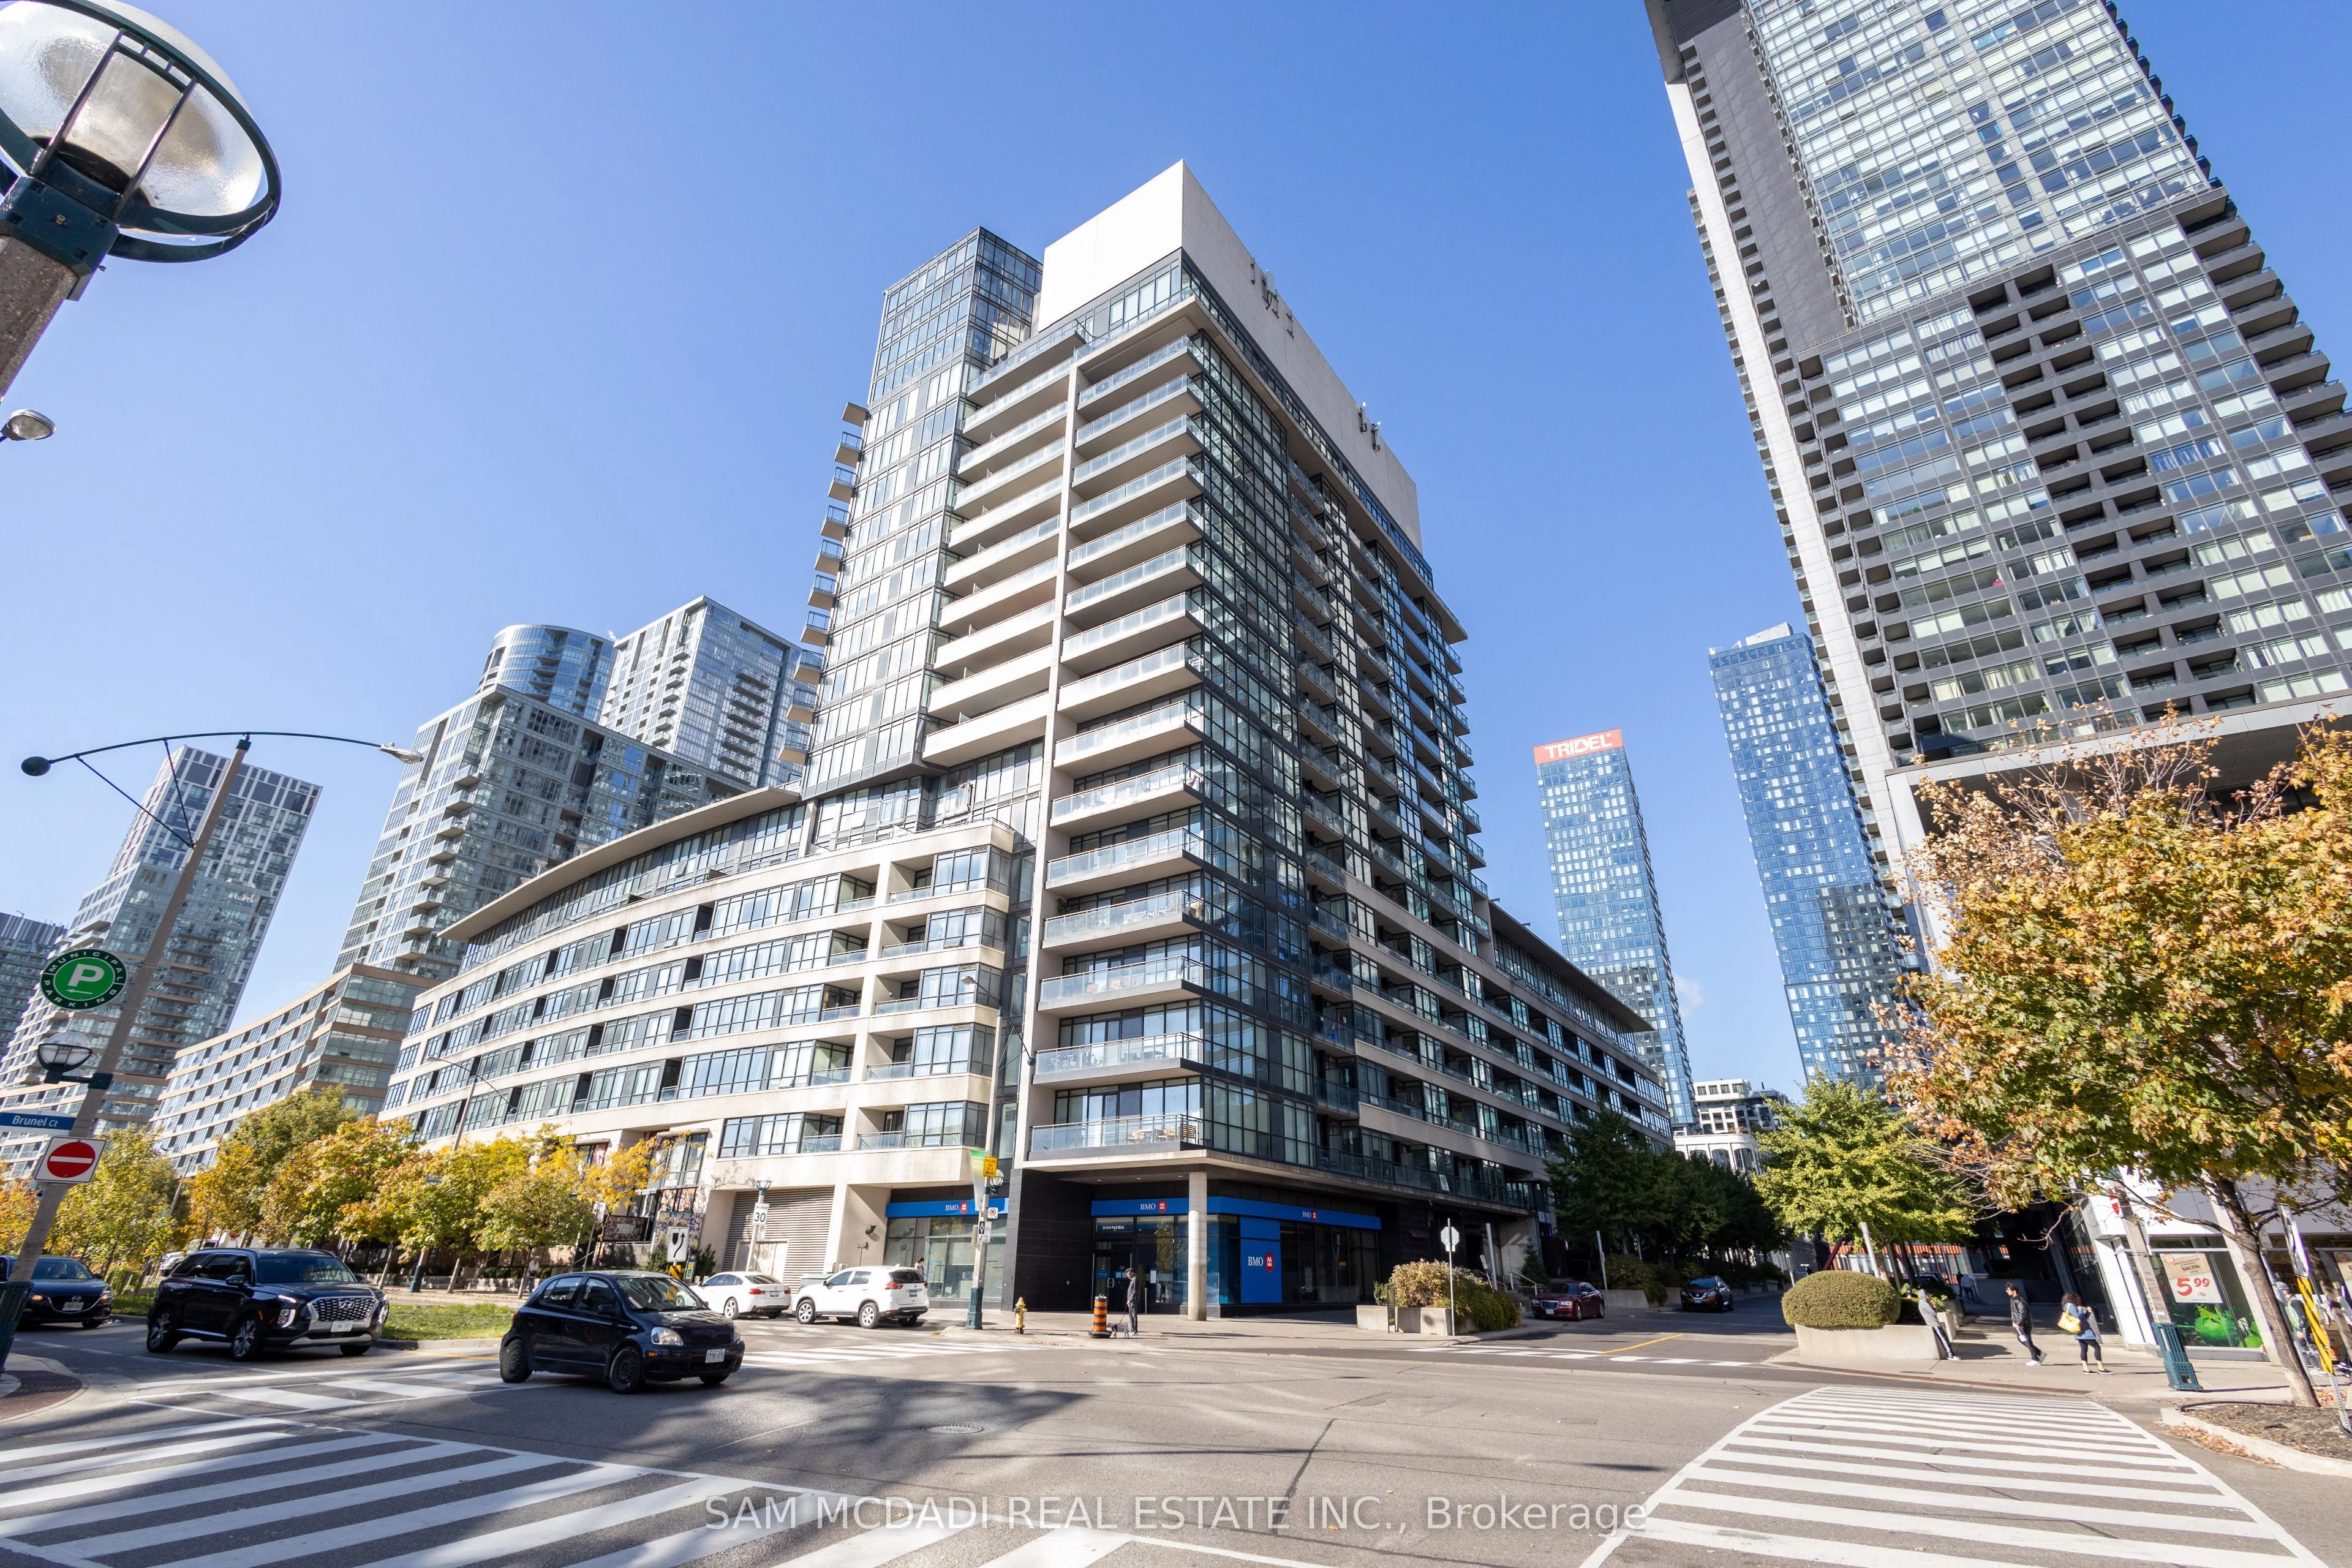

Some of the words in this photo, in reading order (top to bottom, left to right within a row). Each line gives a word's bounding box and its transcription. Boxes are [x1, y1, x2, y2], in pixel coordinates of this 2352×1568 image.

[1544, 734, 1613, 759] TRIDEL
[49, 951, 123, 981] MUNICIPAL
[67, 963, 105, 987] P
[44, 980, 117, 1008] PARKING
[12, 1115, 48, 1126] Brunel
[754, 1212, 766, 1223] 30
[1248, 1256, 1264, 1267] BMO
[2194, 1278, 2210, 1287] 99
